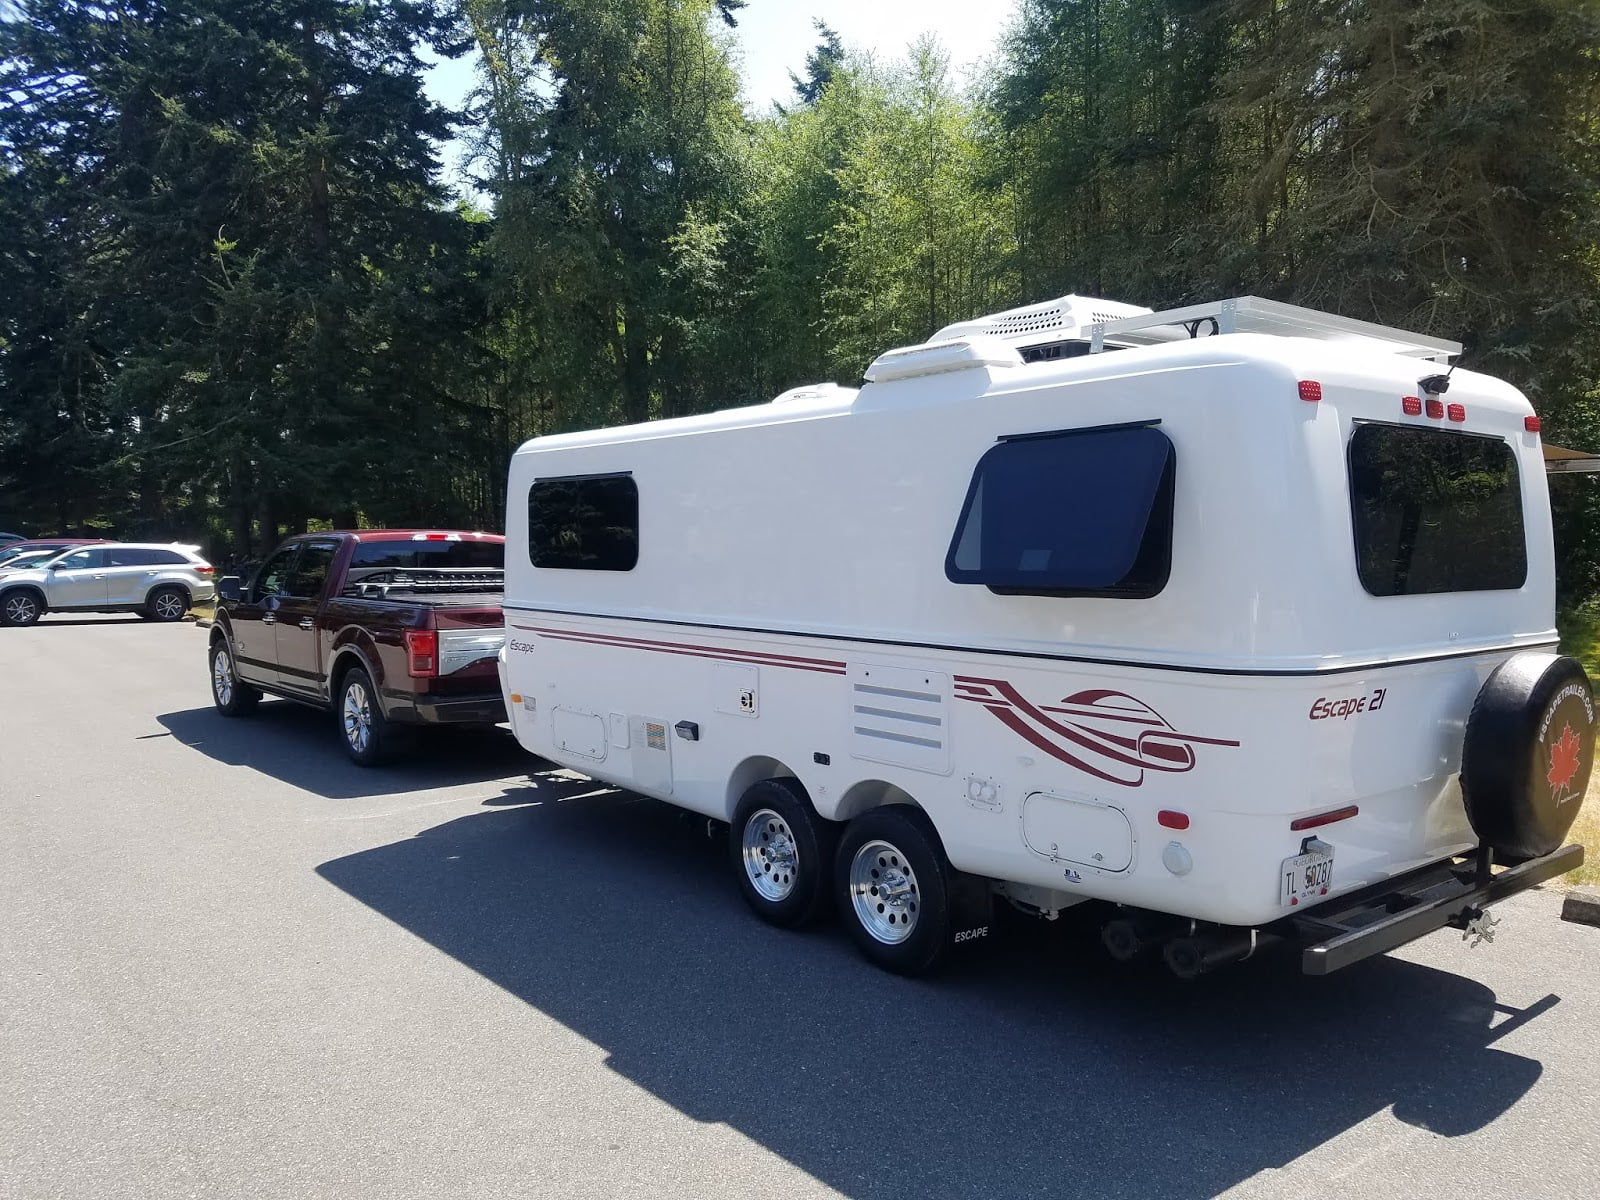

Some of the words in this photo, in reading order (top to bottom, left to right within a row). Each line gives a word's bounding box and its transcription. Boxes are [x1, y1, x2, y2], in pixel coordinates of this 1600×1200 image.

[510, 639, 535, 654] Escape
[1309, 697, 1367, 720] Escape
[1368, 688, 1387, 711] 21
[1540, 684, 1594, 743] ESCAPETRAILER.COM
[1286, 871, 1297, 896] TL
[1304, 859, 1333, 889] 50Z87
[954, 926, 989, 943] ESCAPE
